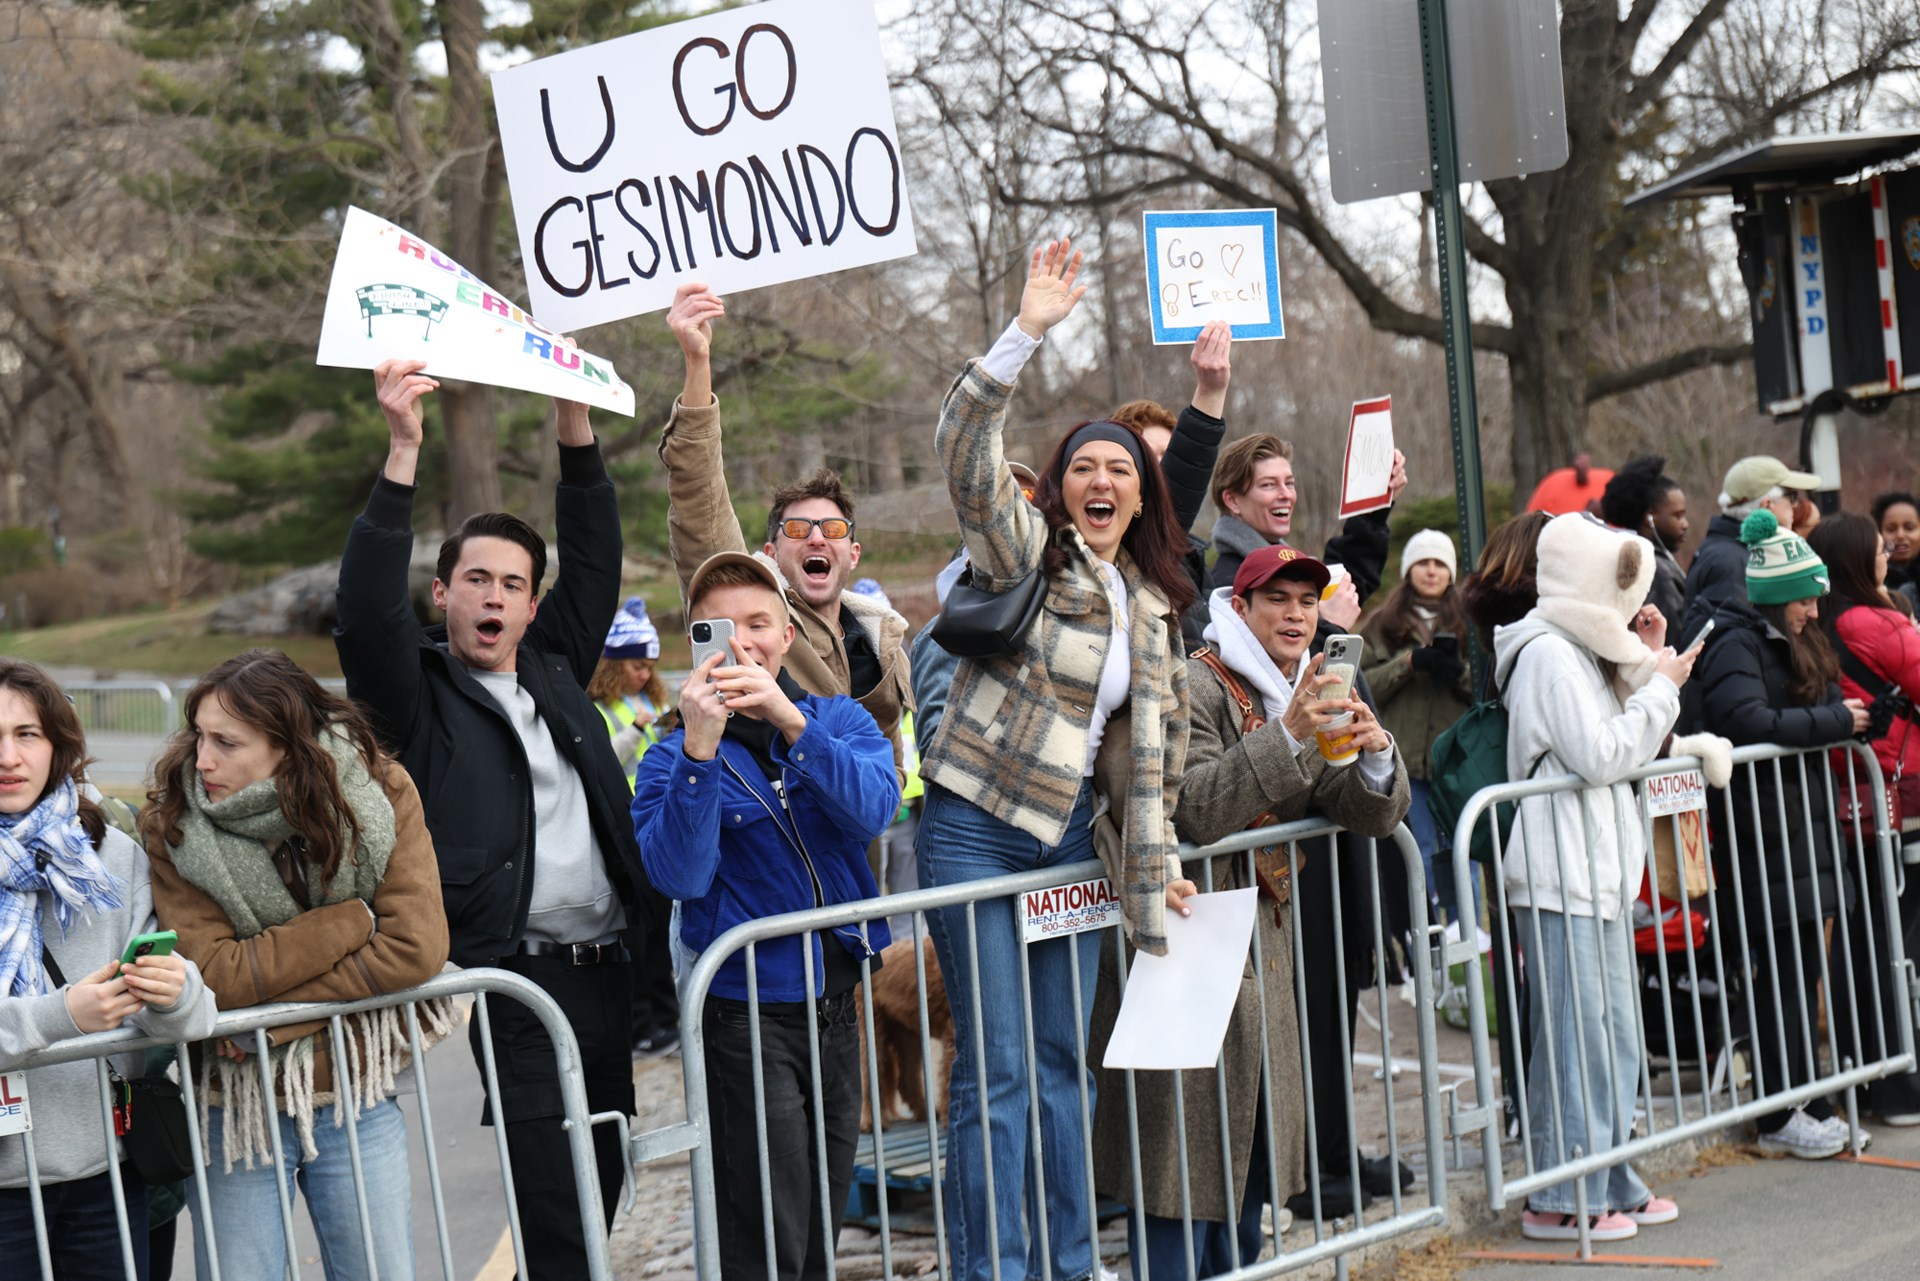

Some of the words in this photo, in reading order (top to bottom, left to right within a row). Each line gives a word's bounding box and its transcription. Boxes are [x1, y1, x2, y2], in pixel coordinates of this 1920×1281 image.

[539, 75, 616, 174] U
[672, 22, 797, 136] GO
[534, 126, 900, 298] GESIMONDO
[1800, 235, 1825, 336] NYPD
[522, 331, 611, 385] RUN
[1648, 771, 1702, 798] NATIONAL
[1027, 880, 1119, 918] NATIONAL
[1028, 902, 1119, 926] RENT-A-FENCE
[1042, 913, 1107, 933] 800-352-5675
